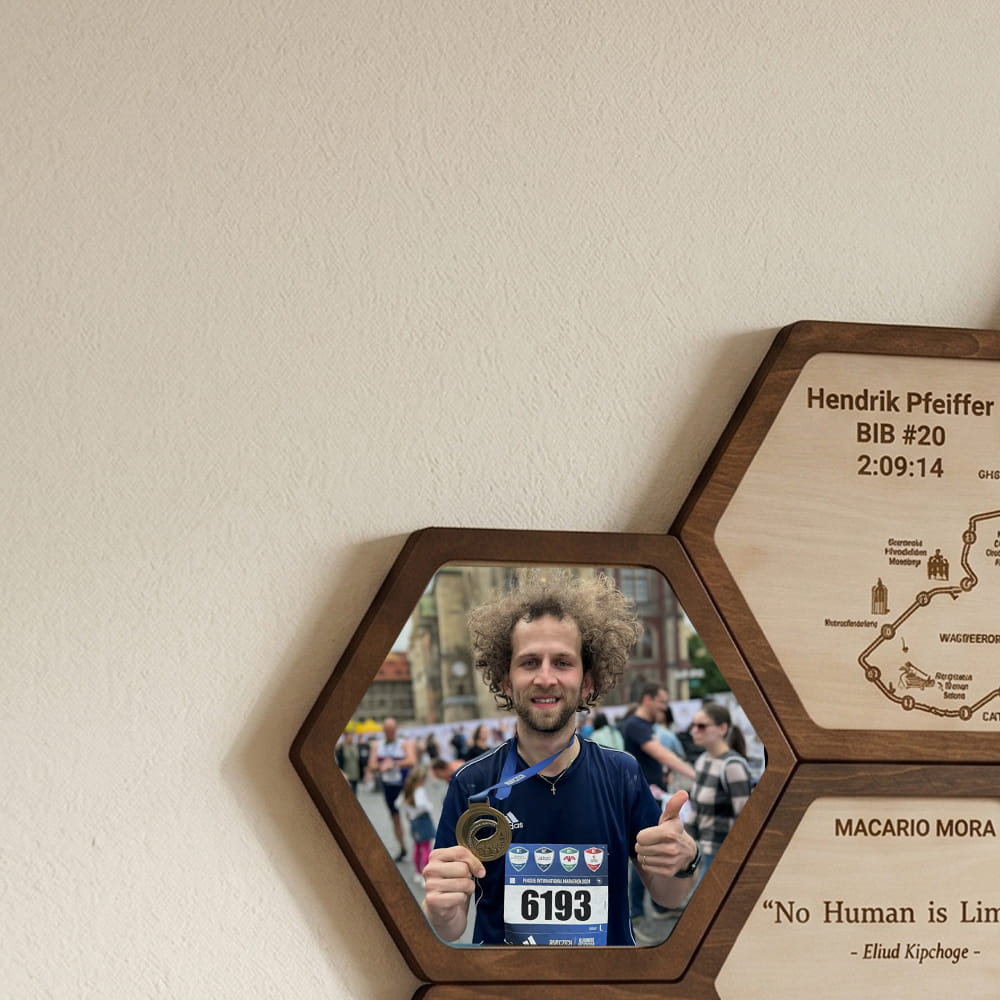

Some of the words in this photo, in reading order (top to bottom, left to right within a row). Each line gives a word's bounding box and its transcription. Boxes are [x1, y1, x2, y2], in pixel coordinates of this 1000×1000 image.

[807, 387, 900, 412] Hendrik
[907, 392, 994, 416] Pfeiffer
[857, 422, 895, 444] BIB
[902, 424, 946, 446] #20
[857, 455, 944, 478] 2:09:14
[835, 818, 930, 837] MACARIO
[936, 819, 997, 837] MORA
[521, 890, 592, 922] 6193
[762, 900, 810, 924] “No
[823, 900, 916, 924] Human
[928, 900, 948, 924] is
[862, 942, 900, 960] Eliud
[904, 942, 969, 965] Kipchoge
